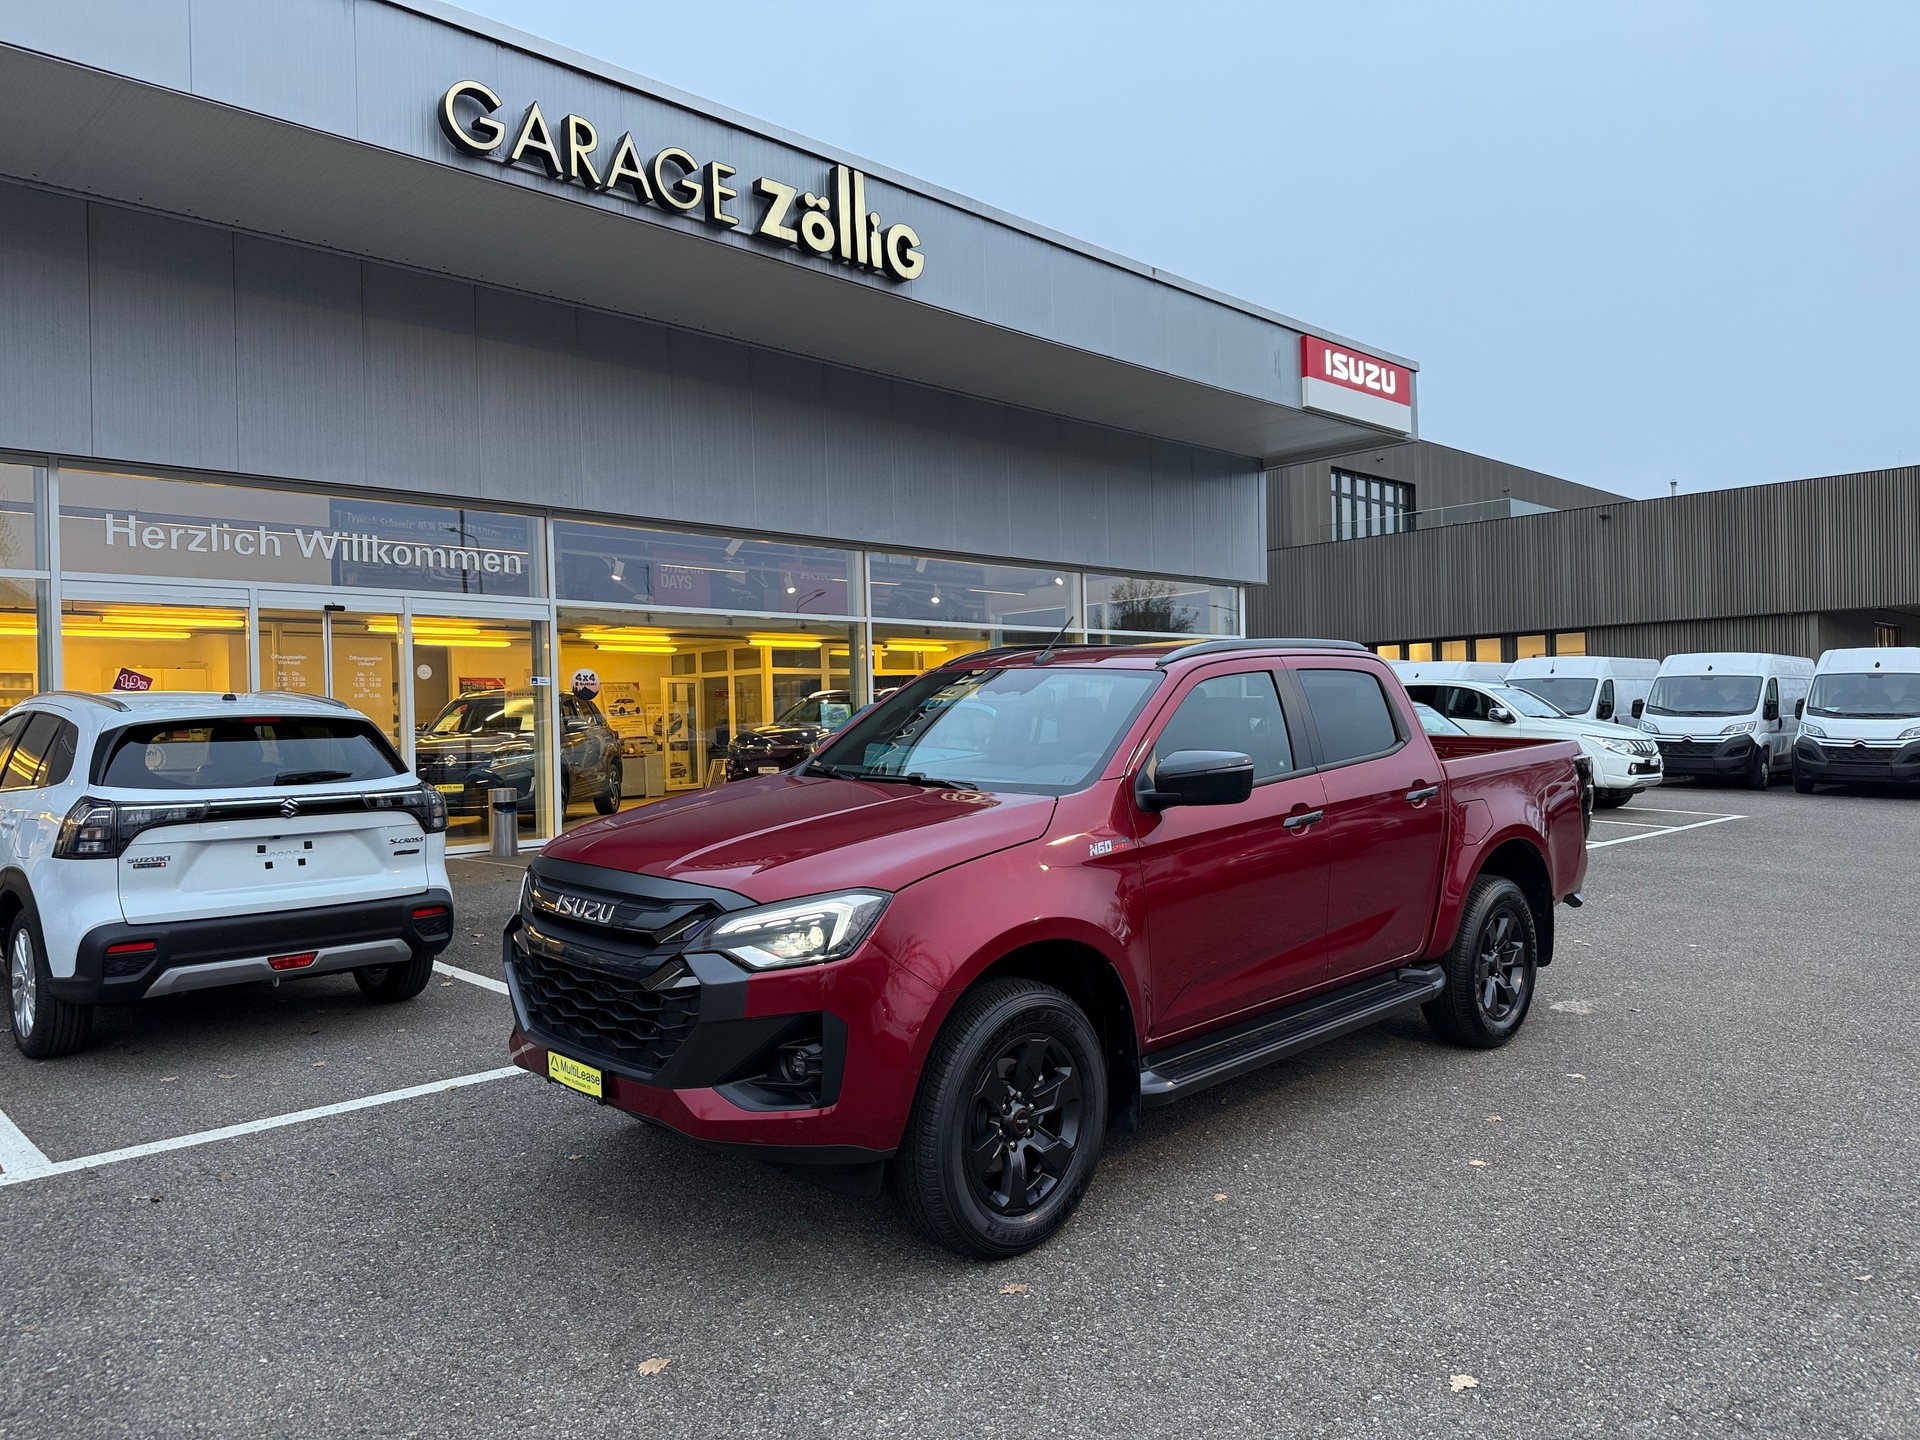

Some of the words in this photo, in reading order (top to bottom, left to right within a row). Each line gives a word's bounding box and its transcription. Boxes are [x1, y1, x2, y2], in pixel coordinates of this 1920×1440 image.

[438, 80, 740, 228] GARAGE
[1325, 349, 1395, 394] ISUZU
[105, 513, 281, 557] Herzlich
[294, 527, 522, 574] Willkommen
[660, 574, 693, 591] DAYS
[575, 673, 596, 682] 4x4
[127, 855, 171, 864] SUZUKI
[1089, 839, 1112, 857] N60
[555, 894, 615, 924] ISUZU
[560, 1059, 601, 1086] MultiLease
